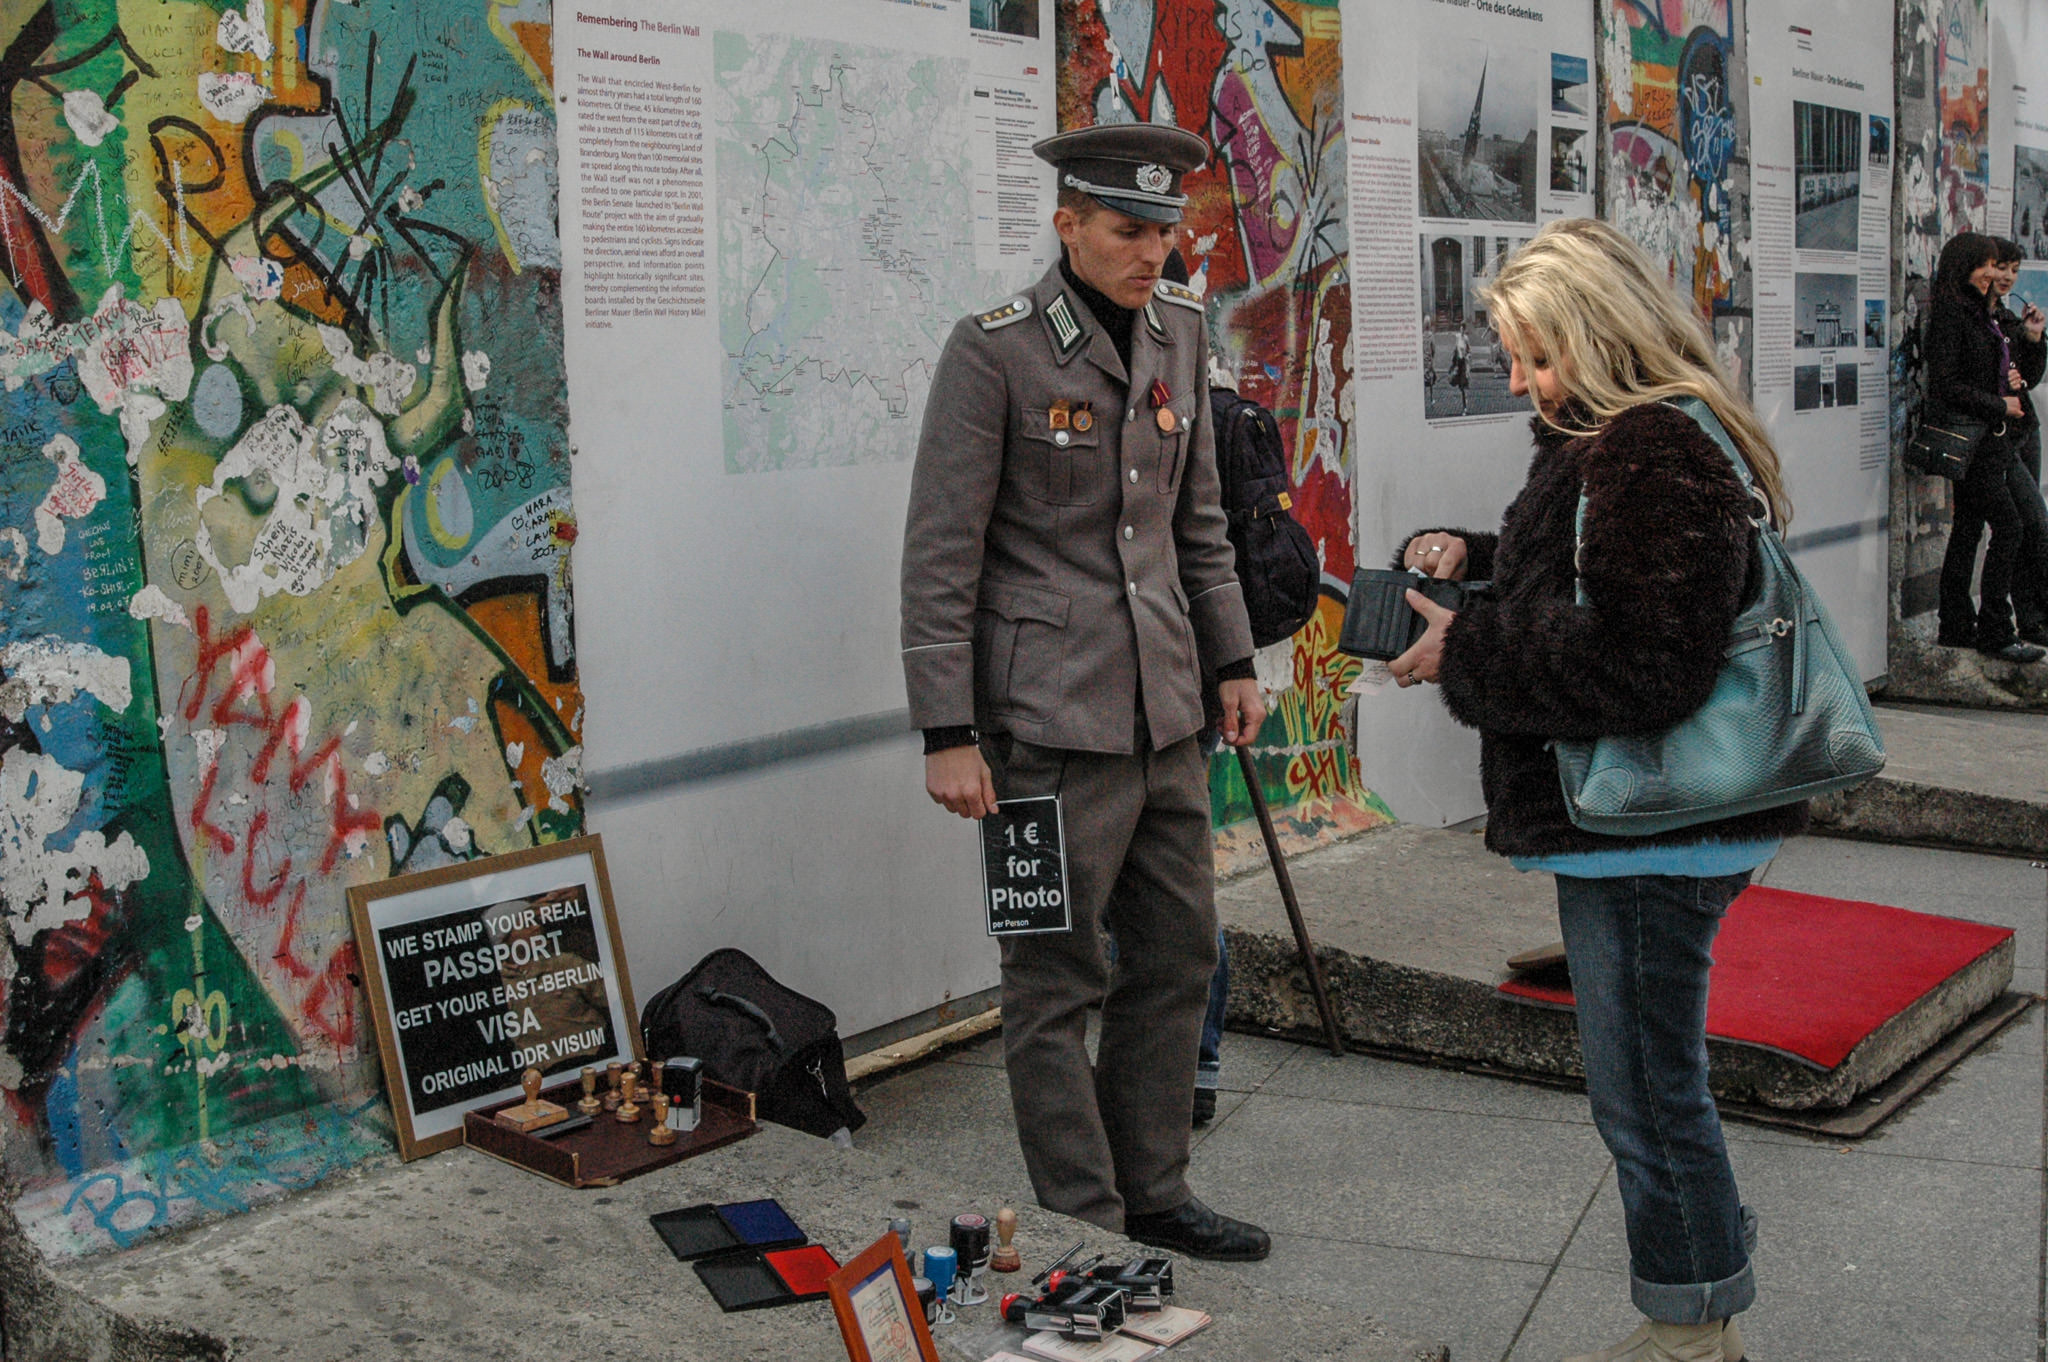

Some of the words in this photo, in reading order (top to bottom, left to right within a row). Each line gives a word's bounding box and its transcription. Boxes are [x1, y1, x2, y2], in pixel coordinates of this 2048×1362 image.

[1476, 0, 1492, 12] Orte
[1494, 1, 1506, 14] des
[1507, 4, 1543, 22] Gedenkens
[576, 11, 637, 30] Remembering
[641, 19, 655, 31] The
[657, 21, 680, 34] Berlin
[682, 24, 699, 36] Wall
[578, 47, 590, 58] The
[592, 49, 608, 60] Wall
[610, 51, 637, 63] around
[638, 54, 659, 65] Berlin
[591, 75, 605, 84] Wall
[608, 76, 621, 85] that
[577, 86, 597, 96] almost
[599, 88, 615, 98] thirty
[617, 91, 632, 100] years
[650, 93, 664, 102] total
[665, 94, 683, 104] length
[686, 110, 700, 118] sepa-
[1351, 113, 1381, 125] Remembering
[578, 123, 595, 132] while
[602, 125, 623, 134] stretch
[614, 138, 628, 147] from
[681, 143, 695, 152] Land
[591, 161, 612, 171] spread
[613, 163, 630, 172] along
[631, 164, 642, 172] this
[644, 165, 659, 173] route
[680, 167, 693, 175] After
[593, 174, 607, 182] Wall
[610, 174, 625, 183] itself
[581, 185, 609, 194] confined
[604, 211, 626, 221] project
[628, 212, 642, 220] with
[664, 237, 680, 246] Signs
[681, 238, 703, 246] indicate
[684, 262, 704, 271] points
[584, 283, 608, 292] thereby
[668, 308, 689, 317] History
[1004, 824, 1015, 846] 1
[1024, 822, 1039, 845] €
[1006, 855, 1041, 878] for
[992, 886, 1062, 910] Photo
[386, 936, 418, 960] WE
[422, 921, 483, 951] STAMP
[485, 910, 537, 937] YOUR
[540, 899, 586, 924] REAL
[992, 920, 1004, 929] per
[1005, 918, 1029, 927] Person
[423, 929, 564, 988] PASSPORT
[396, 1004, 433, 1031] GET
[436, 993, 490, 1021] YOUR
[494, 962, 604, 1005] EAST-BERLIN
[477, 1007, 541, 1045] VISA
[422, 1056, 509, 1095] ORIGINAL
[512, 1048, 550, 1069] DDR
[552, 1027, 605, 1058] VISUM
